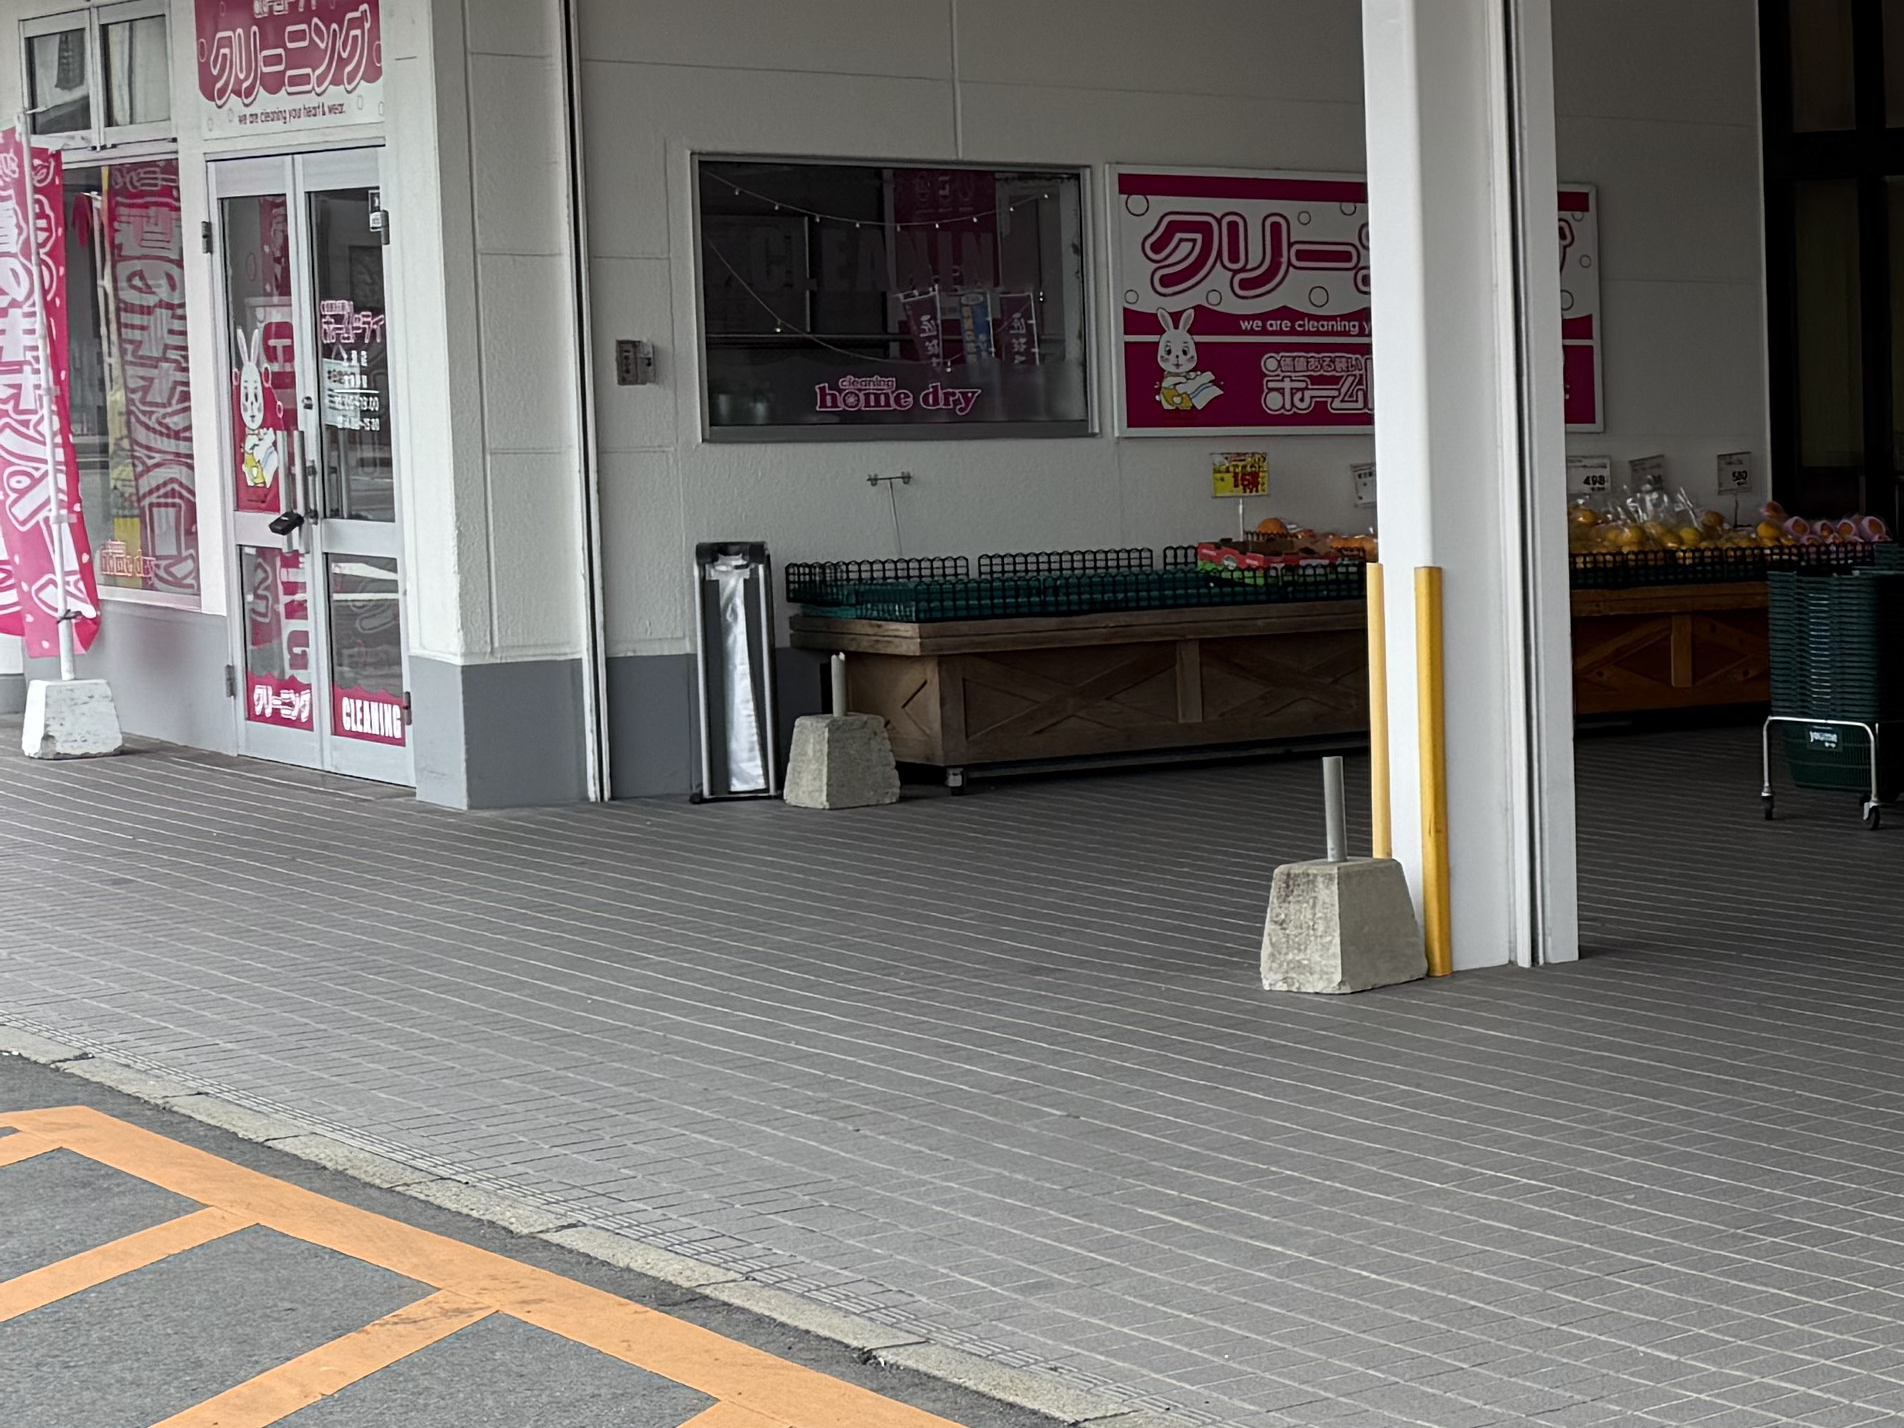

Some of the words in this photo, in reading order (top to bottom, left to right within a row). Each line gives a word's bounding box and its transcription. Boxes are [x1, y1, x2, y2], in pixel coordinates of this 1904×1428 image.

[210, 4, 371, 108] クリーニング
[260, 109, 288, 125] cleaning
[1240, 319, 1262, 331] we
[1265, 320, 1291, 331] are
[1295, 317, 1359, 335] cleaning
[815, 382, 915, 412] home
[920, 382, 981, 416] dry
[253, 684, 311, 723] クリーニング
[341, 696, 402, 739] CLEANING
